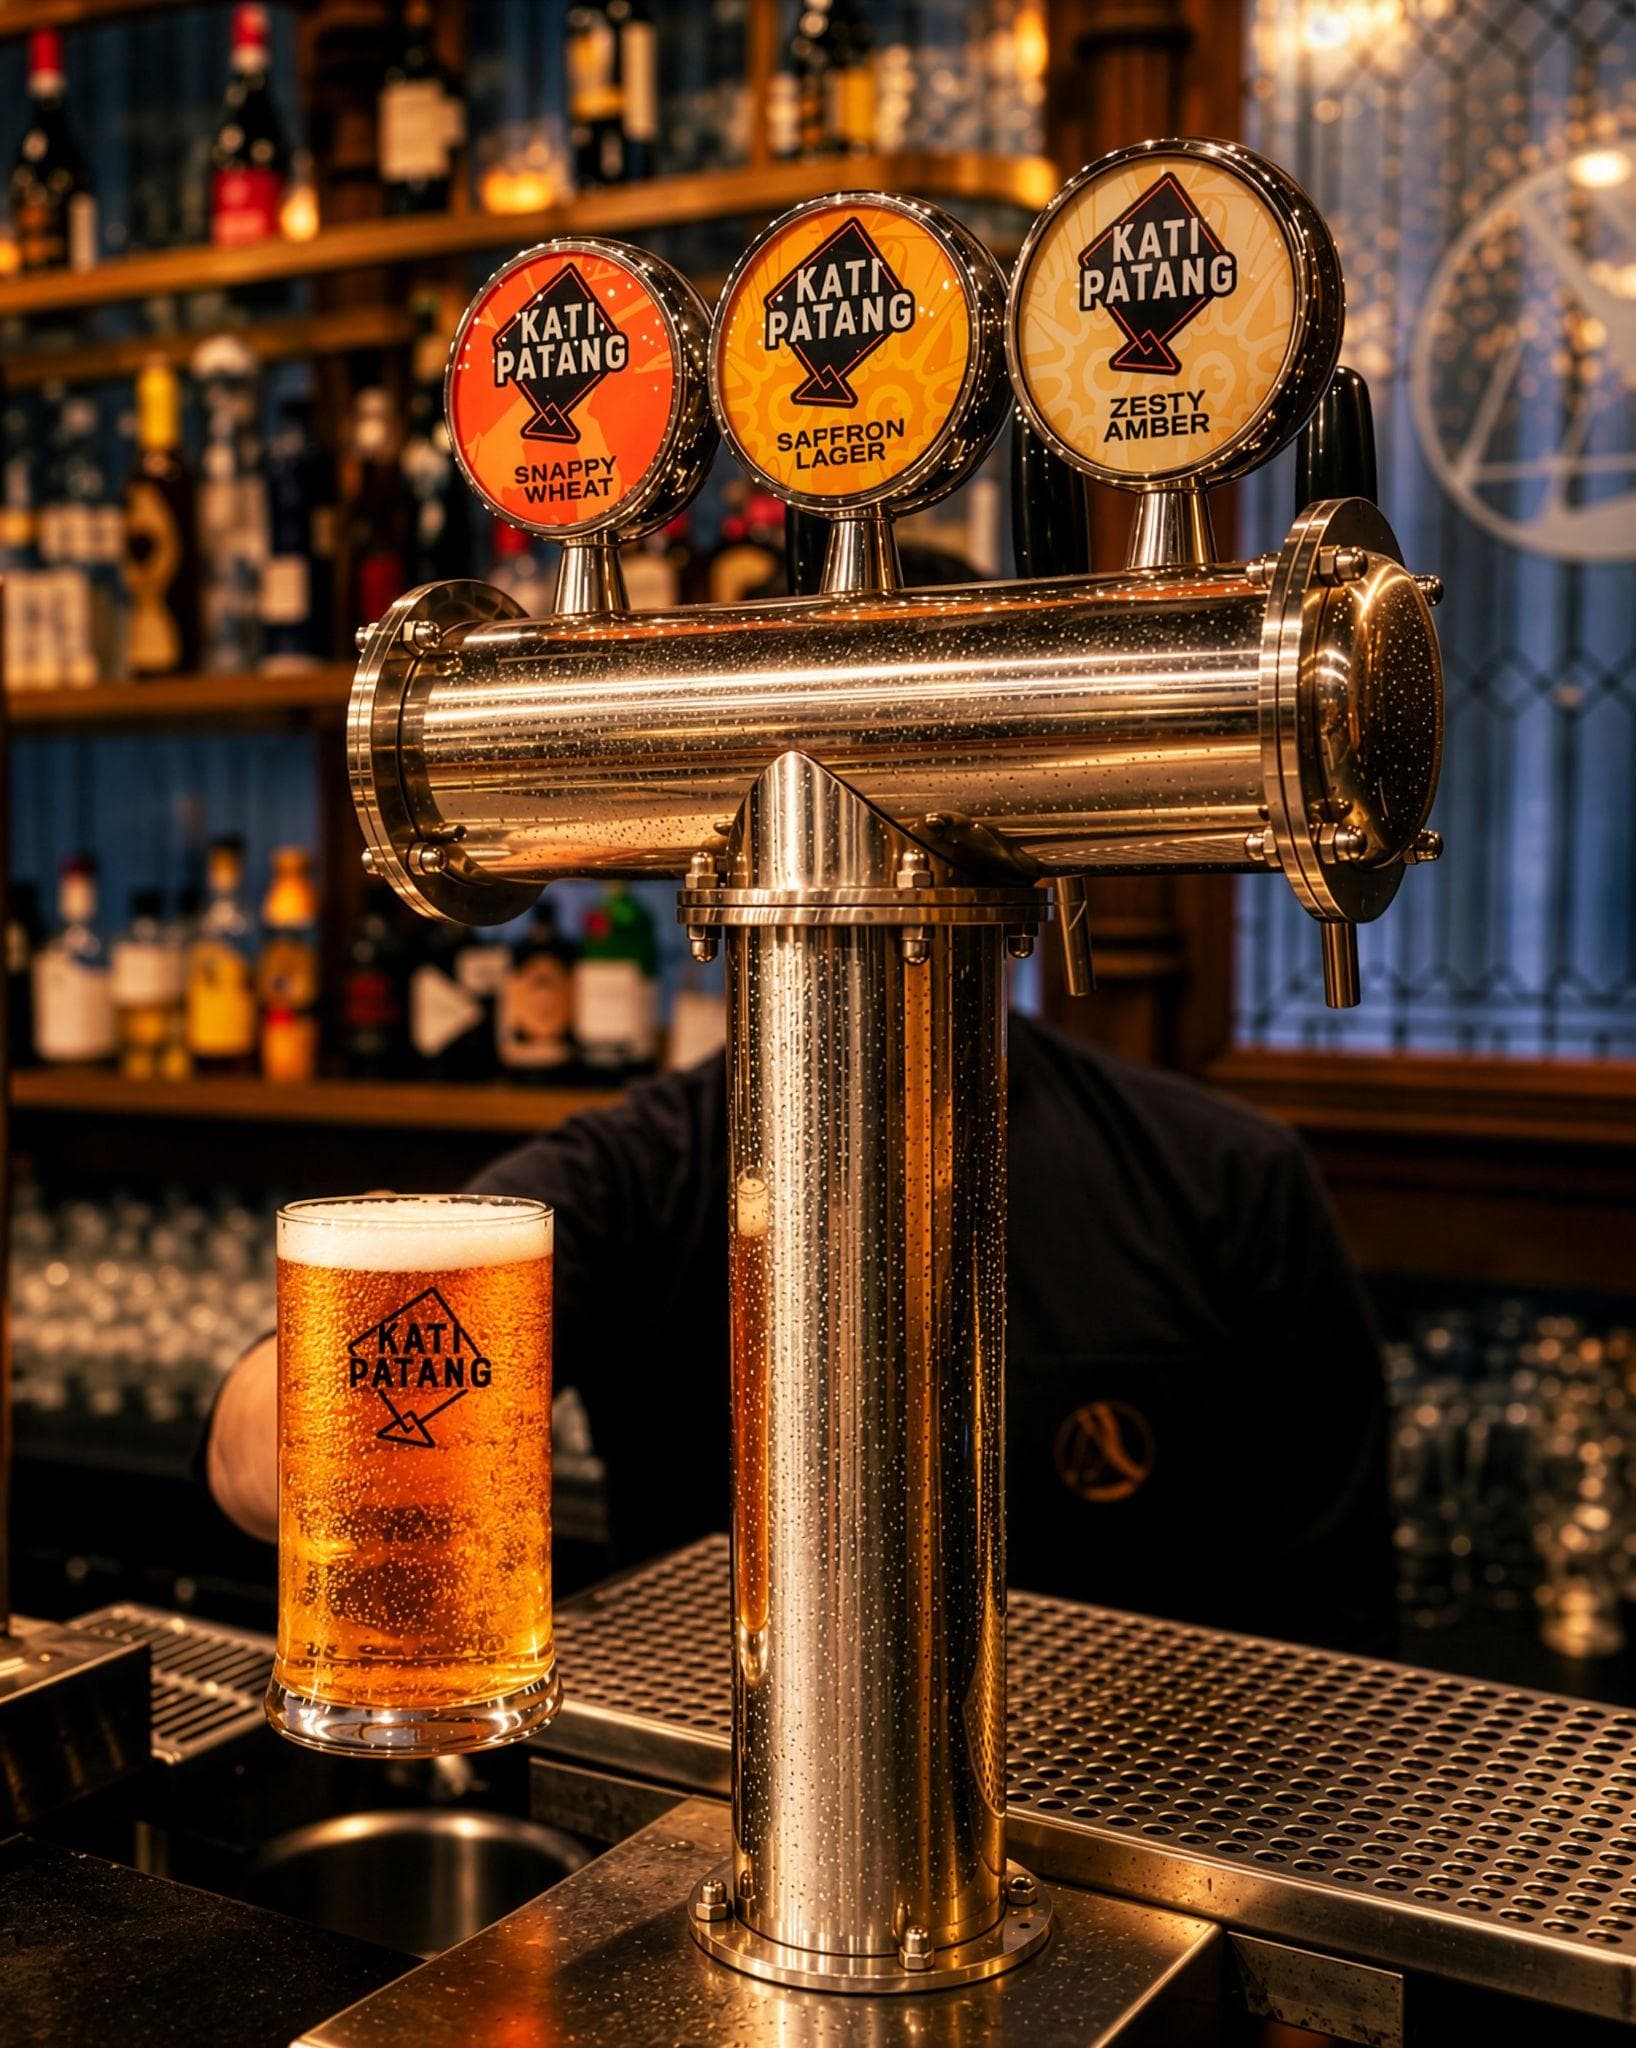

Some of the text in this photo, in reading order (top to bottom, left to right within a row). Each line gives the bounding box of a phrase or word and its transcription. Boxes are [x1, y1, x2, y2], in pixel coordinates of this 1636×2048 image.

[1113, 219, 1199, 262] KATI
[797, 258, 881, 303] KATI
[1084, 256, 1233, 307] PATANG
[521, 302, 597, 344] KATI
[769, 294, 912, 346] PATANG
[497, 335, 626, 383] PATANG
[1110, 390, 1205, 419] ZESTY
[777, 418, 905, 452] SAFFRON
[1104, 413, 1210, 443] AMBER
[515, 456, 617, 484] SNAPPY
[796, 442, 886, 470] LAGER
[524, 478, 614, 504] WHEAT
[378, 1323, 460, 1354] KATI
[349, 1357, 492, 1388] PATANG
